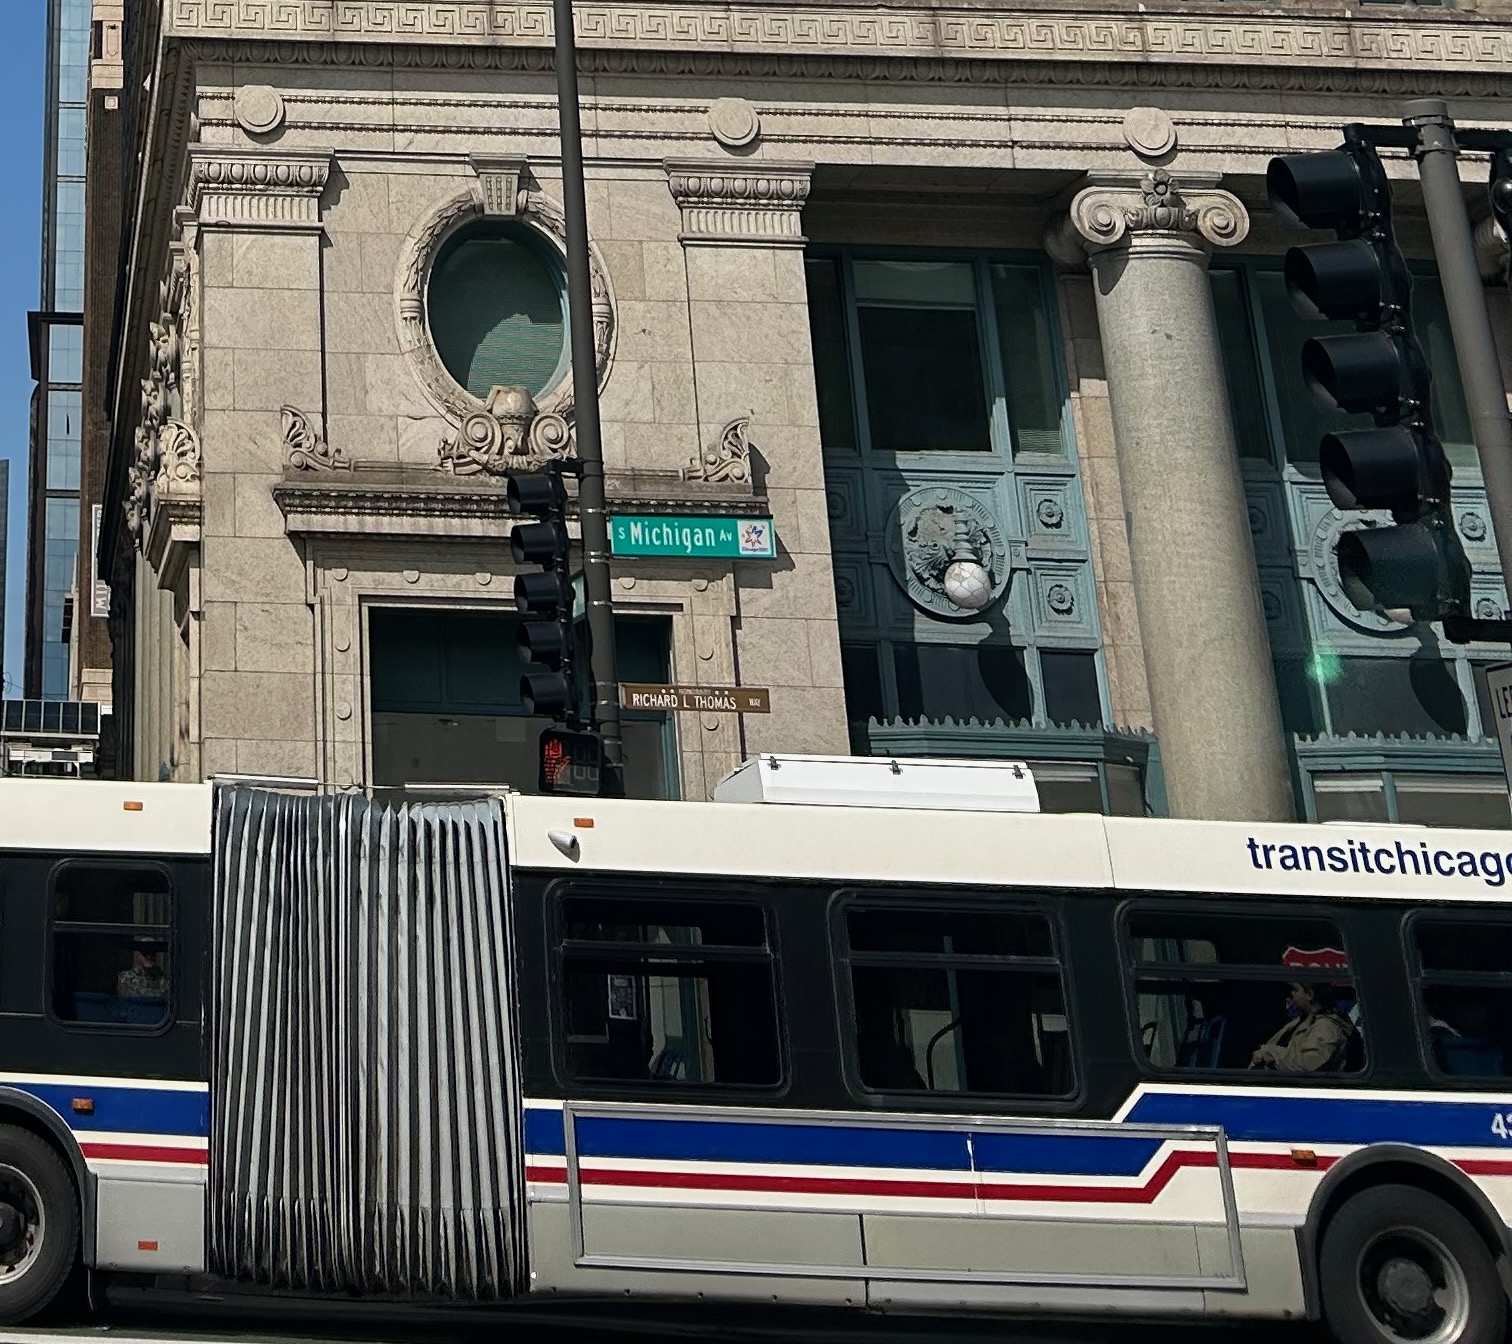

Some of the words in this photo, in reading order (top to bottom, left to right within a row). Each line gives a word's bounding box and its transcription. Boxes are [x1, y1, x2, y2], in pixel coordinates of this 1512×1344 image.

[618, 526, 626, 540] S
[629, 521, 716, 553] Michigan
[719, 529, 733, 542] Av
[632, 693, 678, 708] RICHARD
[683, 696, 690, 708] L
[694, 695, 737, 710] THOMAS
[1495, 685, 1512, 719] LE
[1246, 836, 1512, 887] transitchicag
